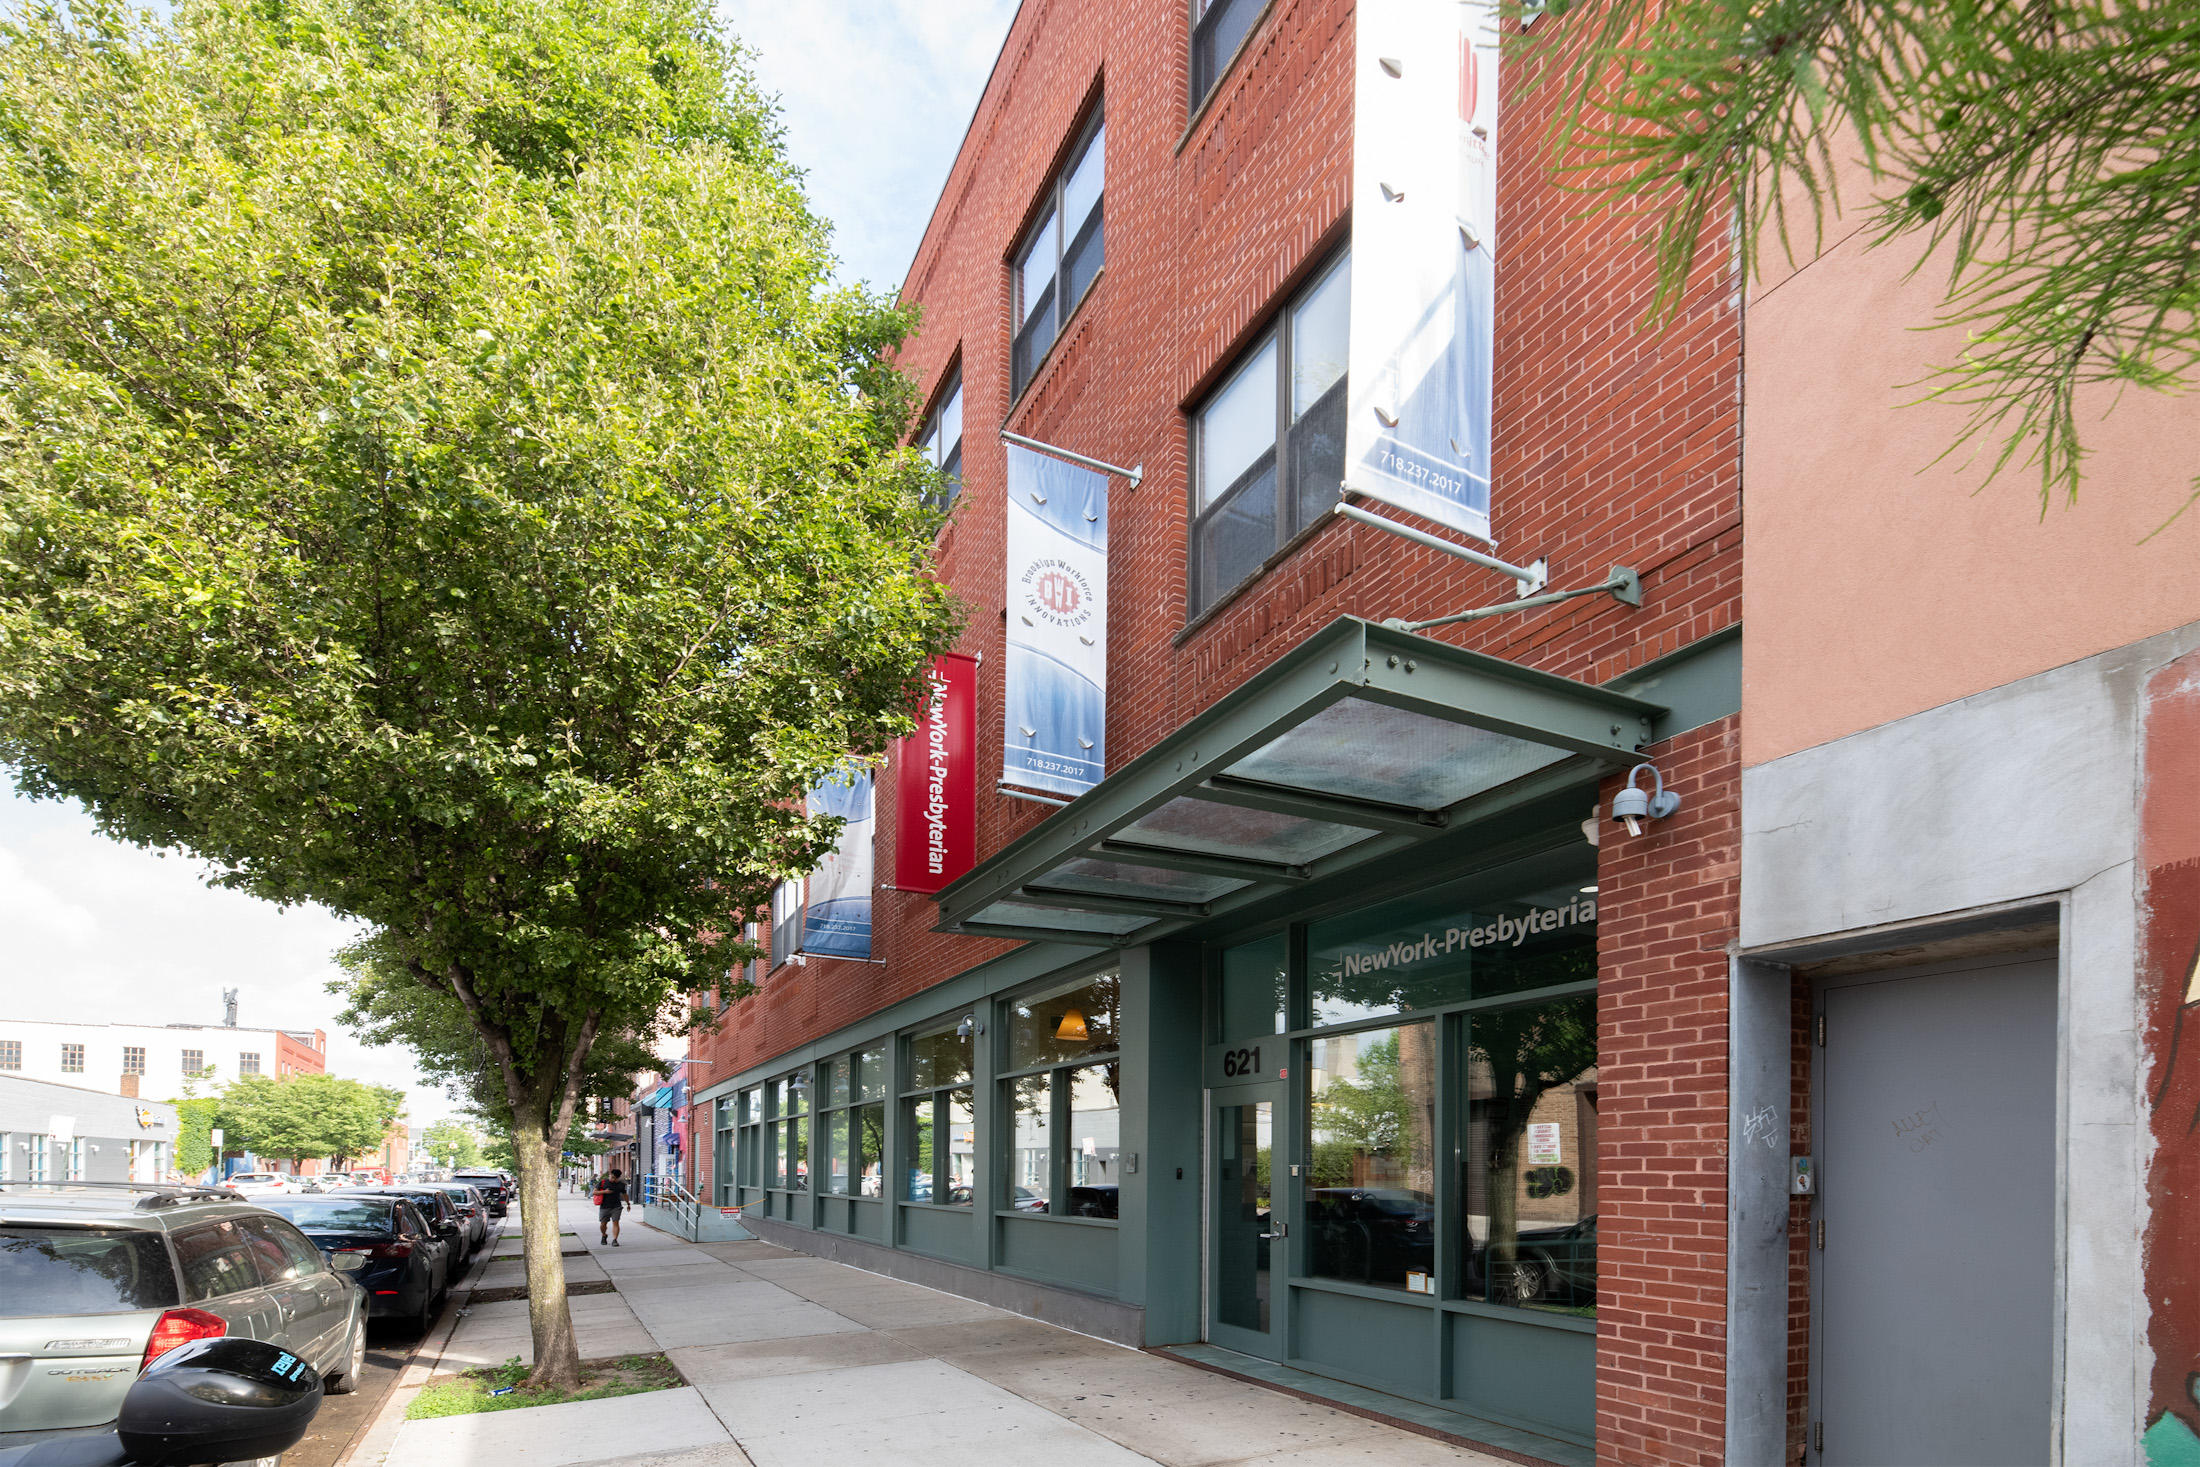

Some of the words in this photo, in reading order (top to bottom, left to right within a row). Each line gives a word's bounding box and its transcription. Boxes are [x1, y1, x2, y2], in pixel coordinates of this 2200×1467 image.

[1380, 450, 1462, 496] 718.237.2017
[1021, 558, 1056, 584] Brooklyn
[1057, 559, 1093, 602] Workforce
[1024, 593, 1092, 627] INNOVATIONS
[1026, 756, 1085, 778] 718.237.2017
[1345, 896, 1597, 978] NewYork-Presbyteria
[1224, 1046, 1261, 1077] 621
